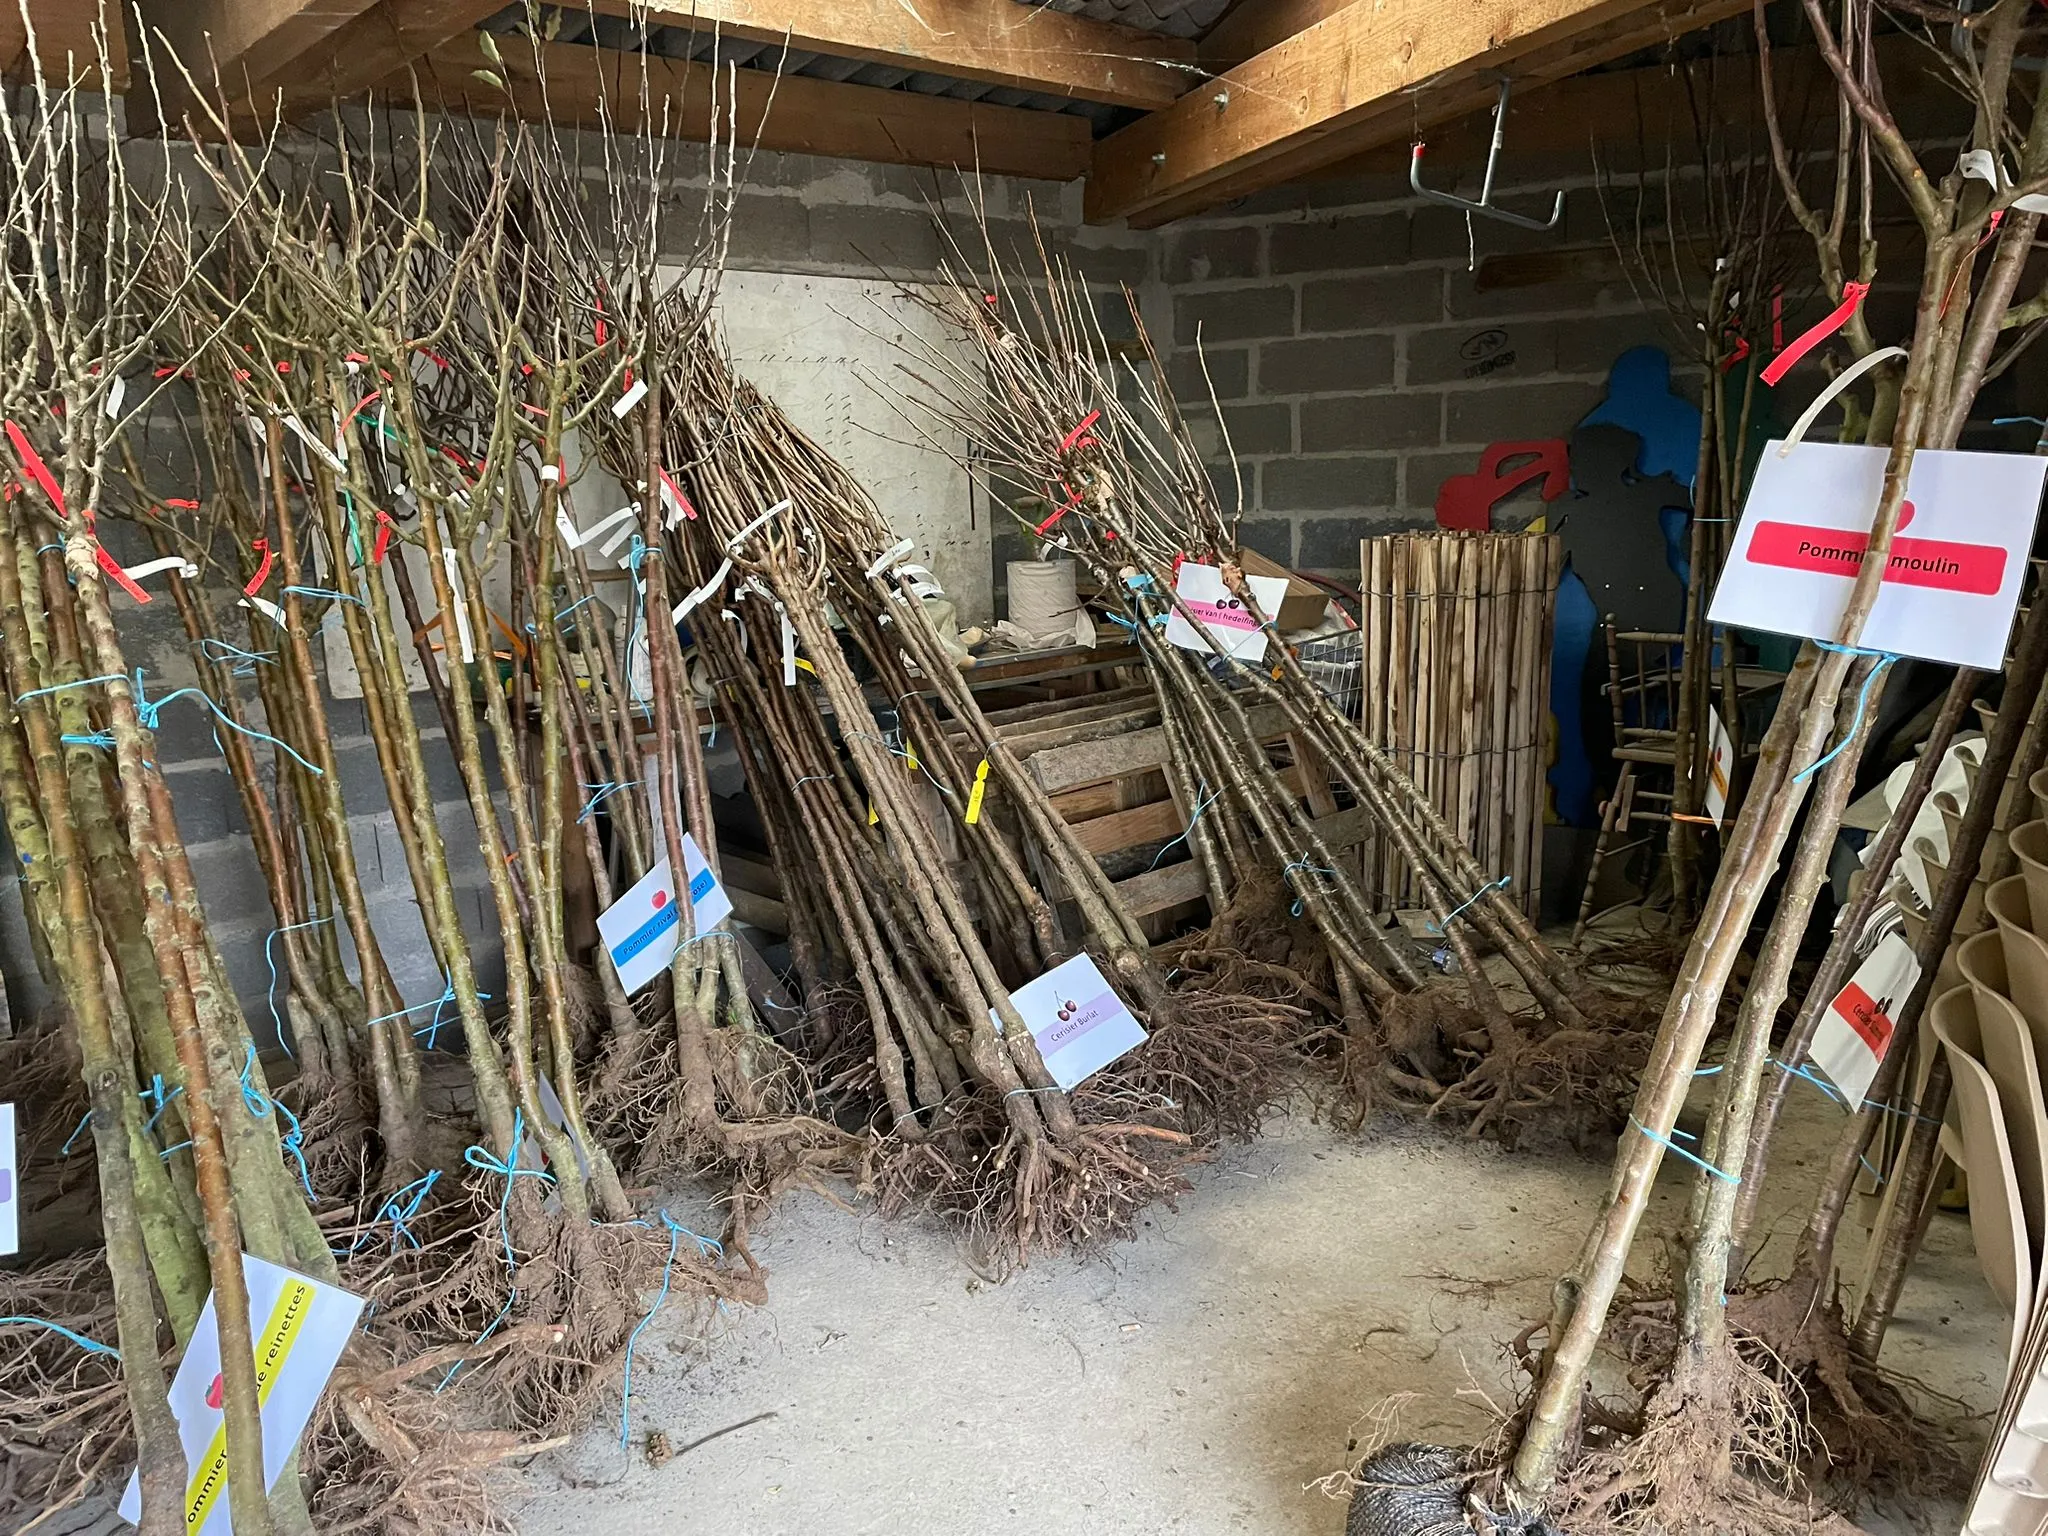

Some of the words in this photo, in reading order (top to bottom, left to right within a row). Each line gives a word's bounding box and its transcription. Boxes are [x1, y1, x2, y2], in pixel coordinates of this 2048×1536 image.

[1798, 541, 1867, 564] Pommi
[1891, 555, 1960, 575] moulin
[1205, 609, 1217, 618] Van
[623, 924, 657, 955] Pommier
[657, 911, 674, 928] rival
[1050, 1022, 1078, 1041] Cerisier
[1077, 1010, 1099, 1025] Burlat
[187, 1449, 227, 1523] ommier
[264, 1285, 306, 1367] reinettes
